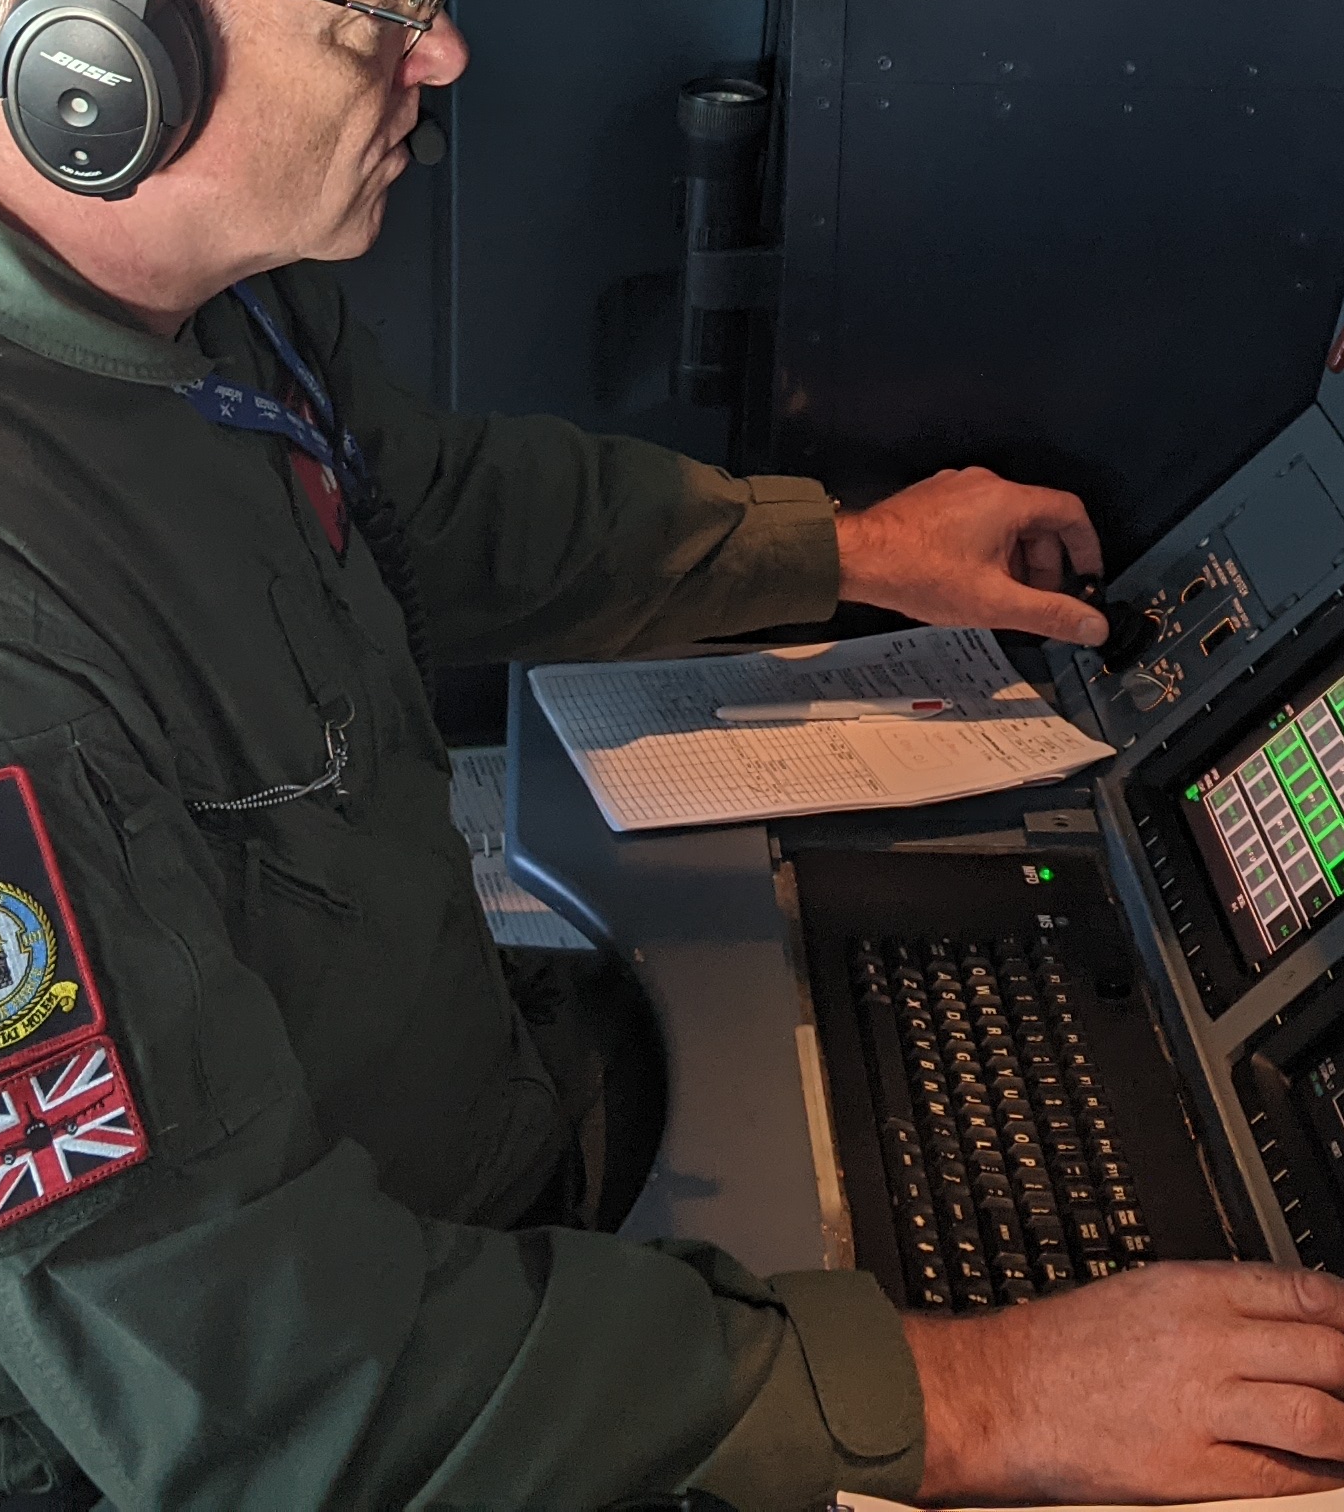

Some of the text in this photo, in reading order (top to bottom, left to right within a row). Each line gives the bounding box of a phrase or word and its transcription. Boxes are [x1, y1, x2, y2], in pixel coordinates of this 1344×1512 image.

[40, 51, 132, 86] BOSE
[1022, 866, 1040, 884] MFD
[938, 972, 951, 980] A
[972, 968, 986, 976] Q
[904, 979, 917, 989] Z
[976, 986, 990, 995] W
[942, 992, 955, 1000] S
[907, 999, 921, 1008] X
[24, 991, 57, 1032] MOLEM
[946, 1011, 960, 1020] D
[982, 1007, 997, 1015] E
[913, 1020, 925, 1029] C
[987, 1027, 1002, 1035] R
[951, 1032, 966, 1040] F
[916, 1041, 930, 1050] V
[957, 1053, 970, 1061] G
[920, 1060, 935, 1070] B
[998, 1069, 1013, 1077] Y
[961, 1074, 975, 1082] H
[924, 1081, 938, 1092] N
[1004, 1090, 1018, 1099] U
[929, 1102, 945, 1115] M
[970, 1117, 986, 1126] K
[1014, 1134, 1029, 1143] O
[1020, 1158, 1035, 1167] P
